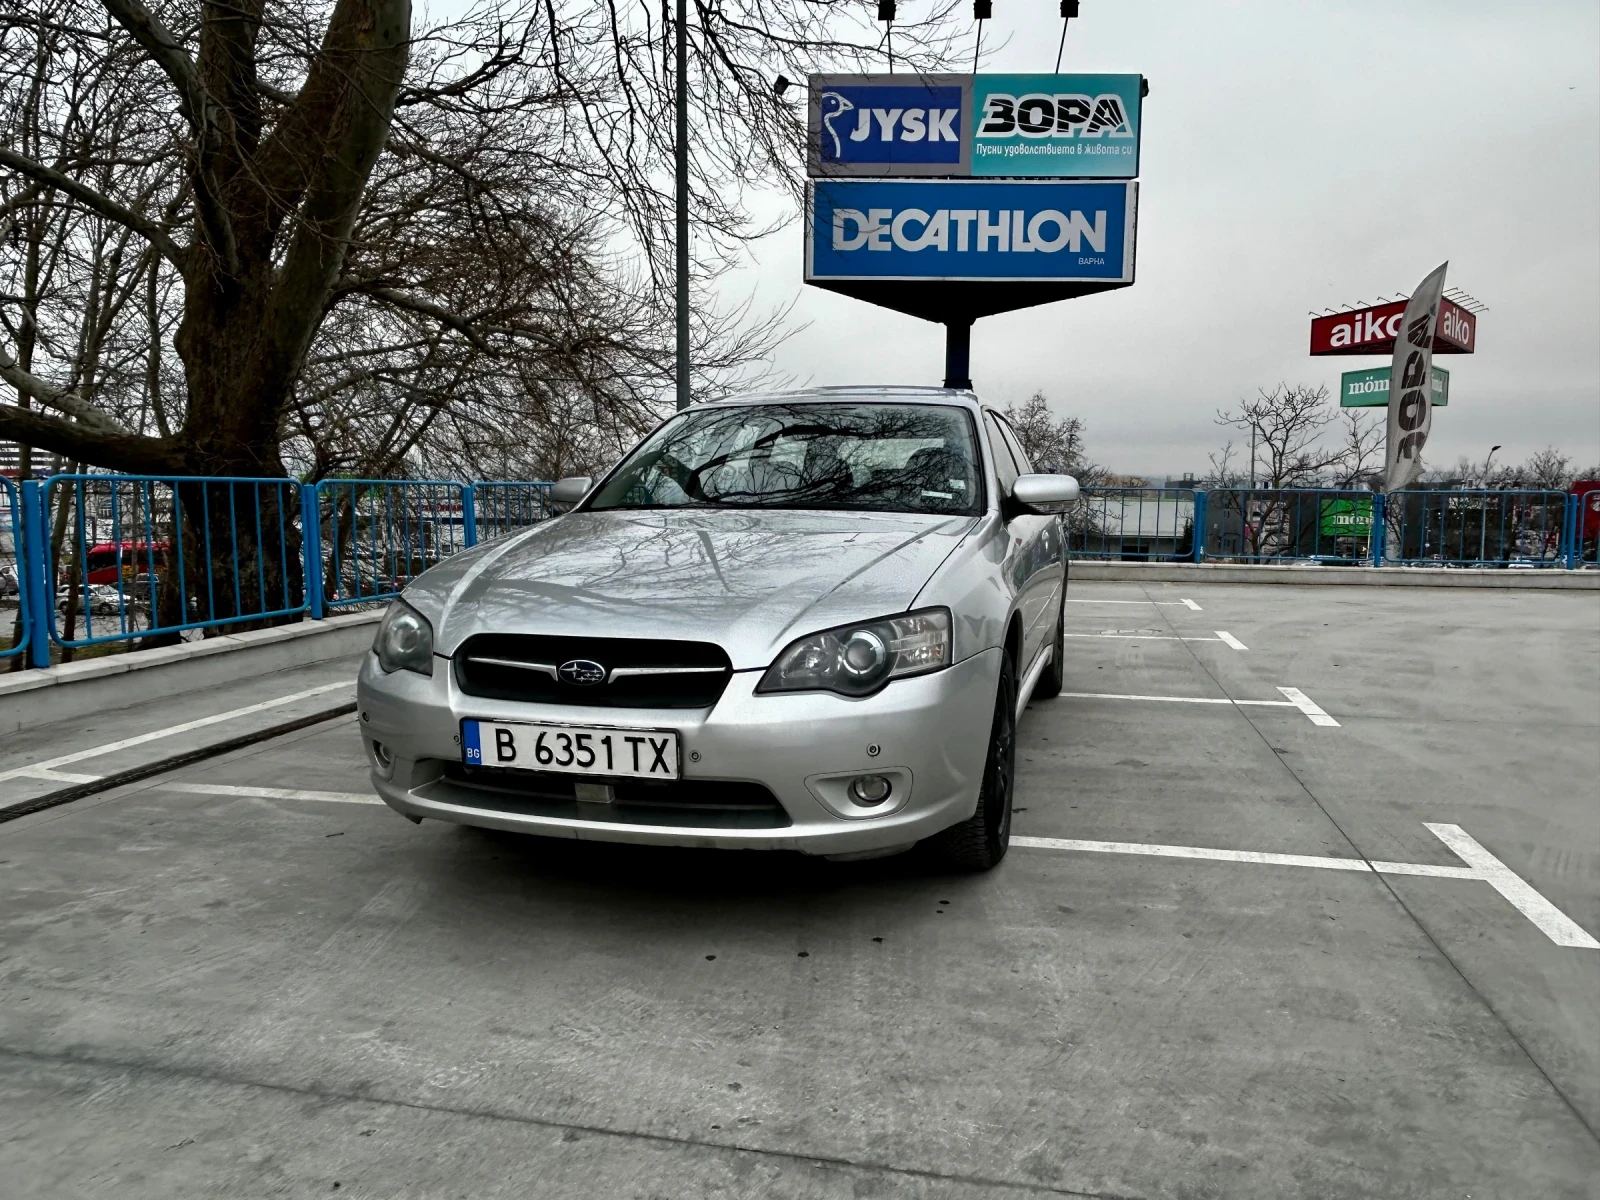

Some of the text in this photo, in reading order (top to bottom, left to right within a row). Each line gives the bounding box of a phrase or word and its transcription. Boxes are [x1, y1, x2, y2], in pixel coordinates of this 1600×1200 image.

[850, 108, 960, 142] JYSK
[977, 95, 1132, 137] ЗОРА
[976, 143, 1002, 156] Пусни
[1004, 143, 1075, 157] удоволствието
[1084, 143, 1119, 155] живота
[1121, 145, 1132, 155] си
[832, 208, 1107, 253] DECATHLON
[1078, 257, 1105, 265] ВАРНА
[1330, 311, 1404, 347] aiko
[1443, 307, 1470, 345] aiko
[1348, 375, 1390, 395] möm
[467, 747, 480, 758] BG
[494, 728, 517, 762] B
